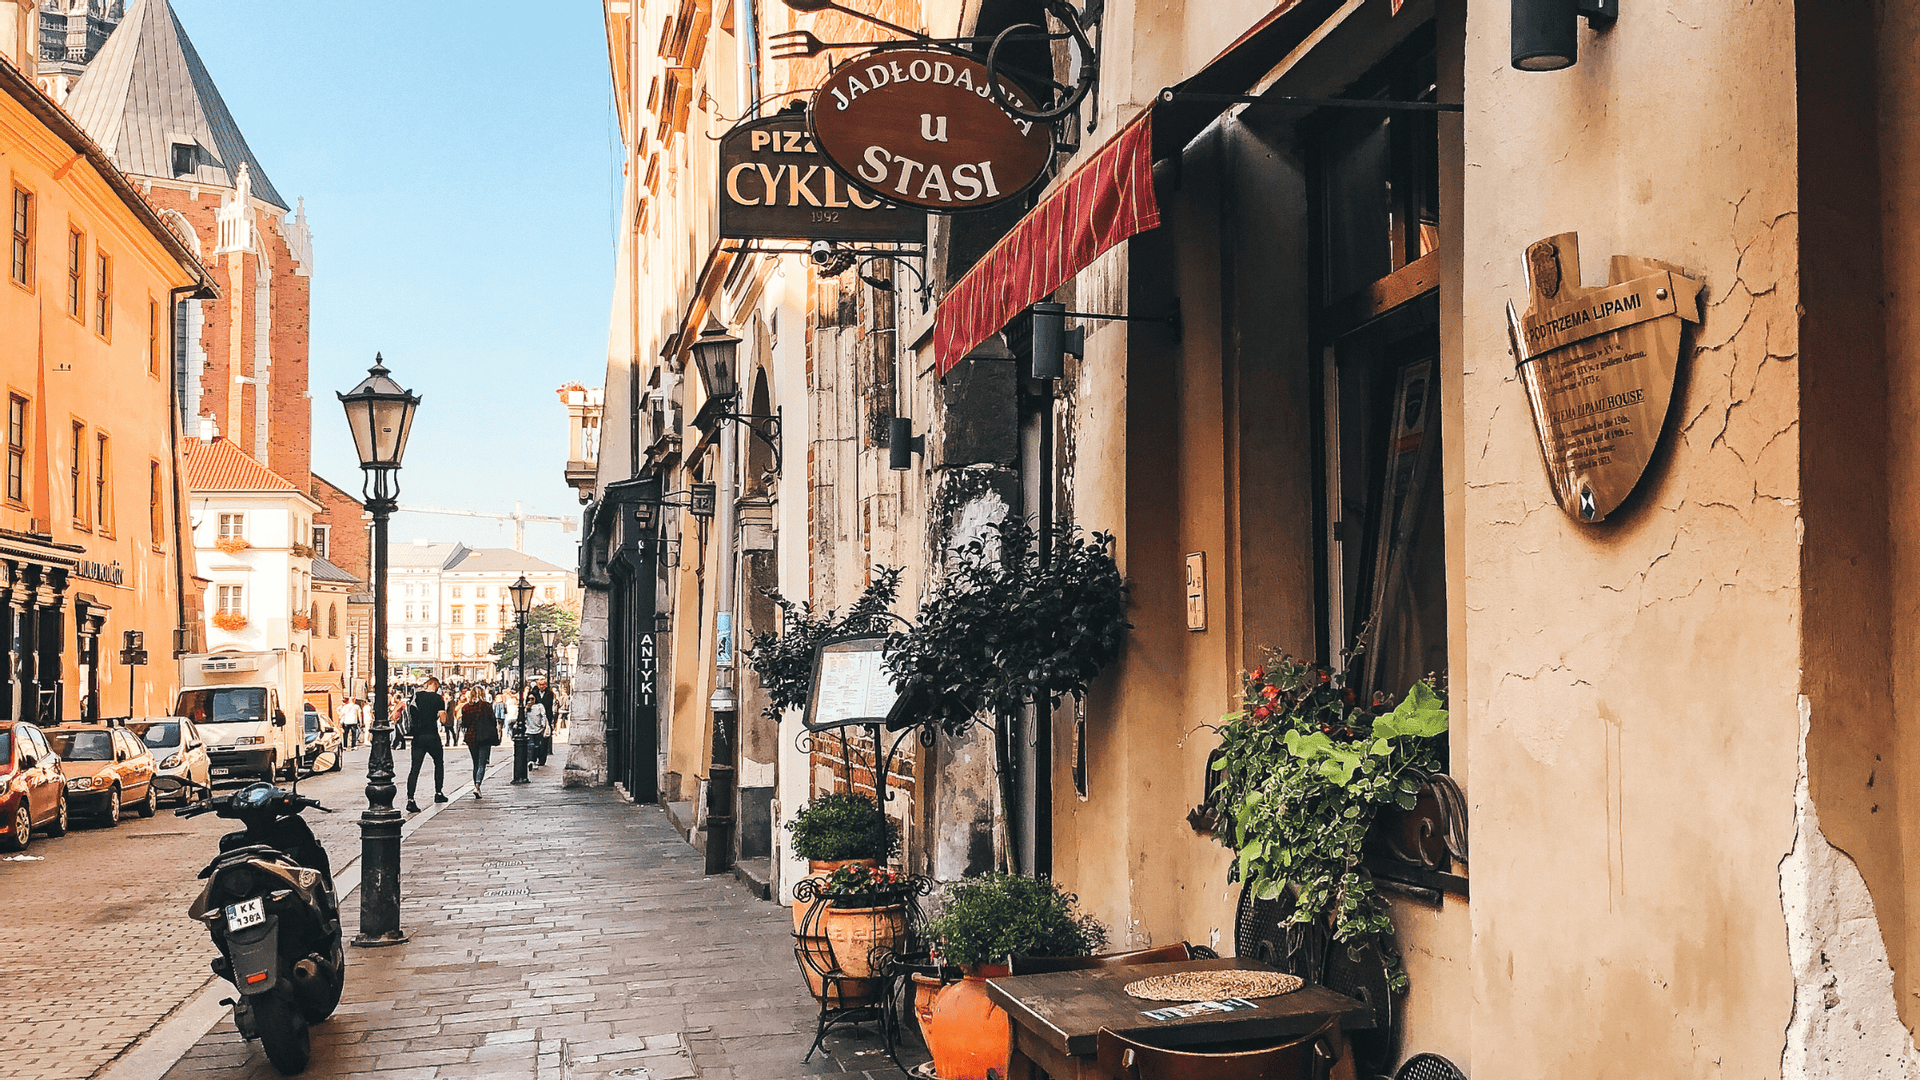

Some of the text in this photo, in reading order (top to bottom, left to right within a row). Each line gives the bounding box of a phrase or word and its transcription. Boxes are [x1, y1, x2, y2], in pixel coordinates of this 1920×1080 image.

[920, 114, 948, 142] u
[751, 130, 818, 153] PIZZ
[858, 145, 1000, 201] STASI
[811, 211, 840, 223] 1992
[1529, 293, 1642, 342] POD TRZEMA LIPAMI
[1606, 388, 1645, 409] HOUSE
[641, 634, 653, 705] ANTYKI
[240, 901, 256, 914] KK
